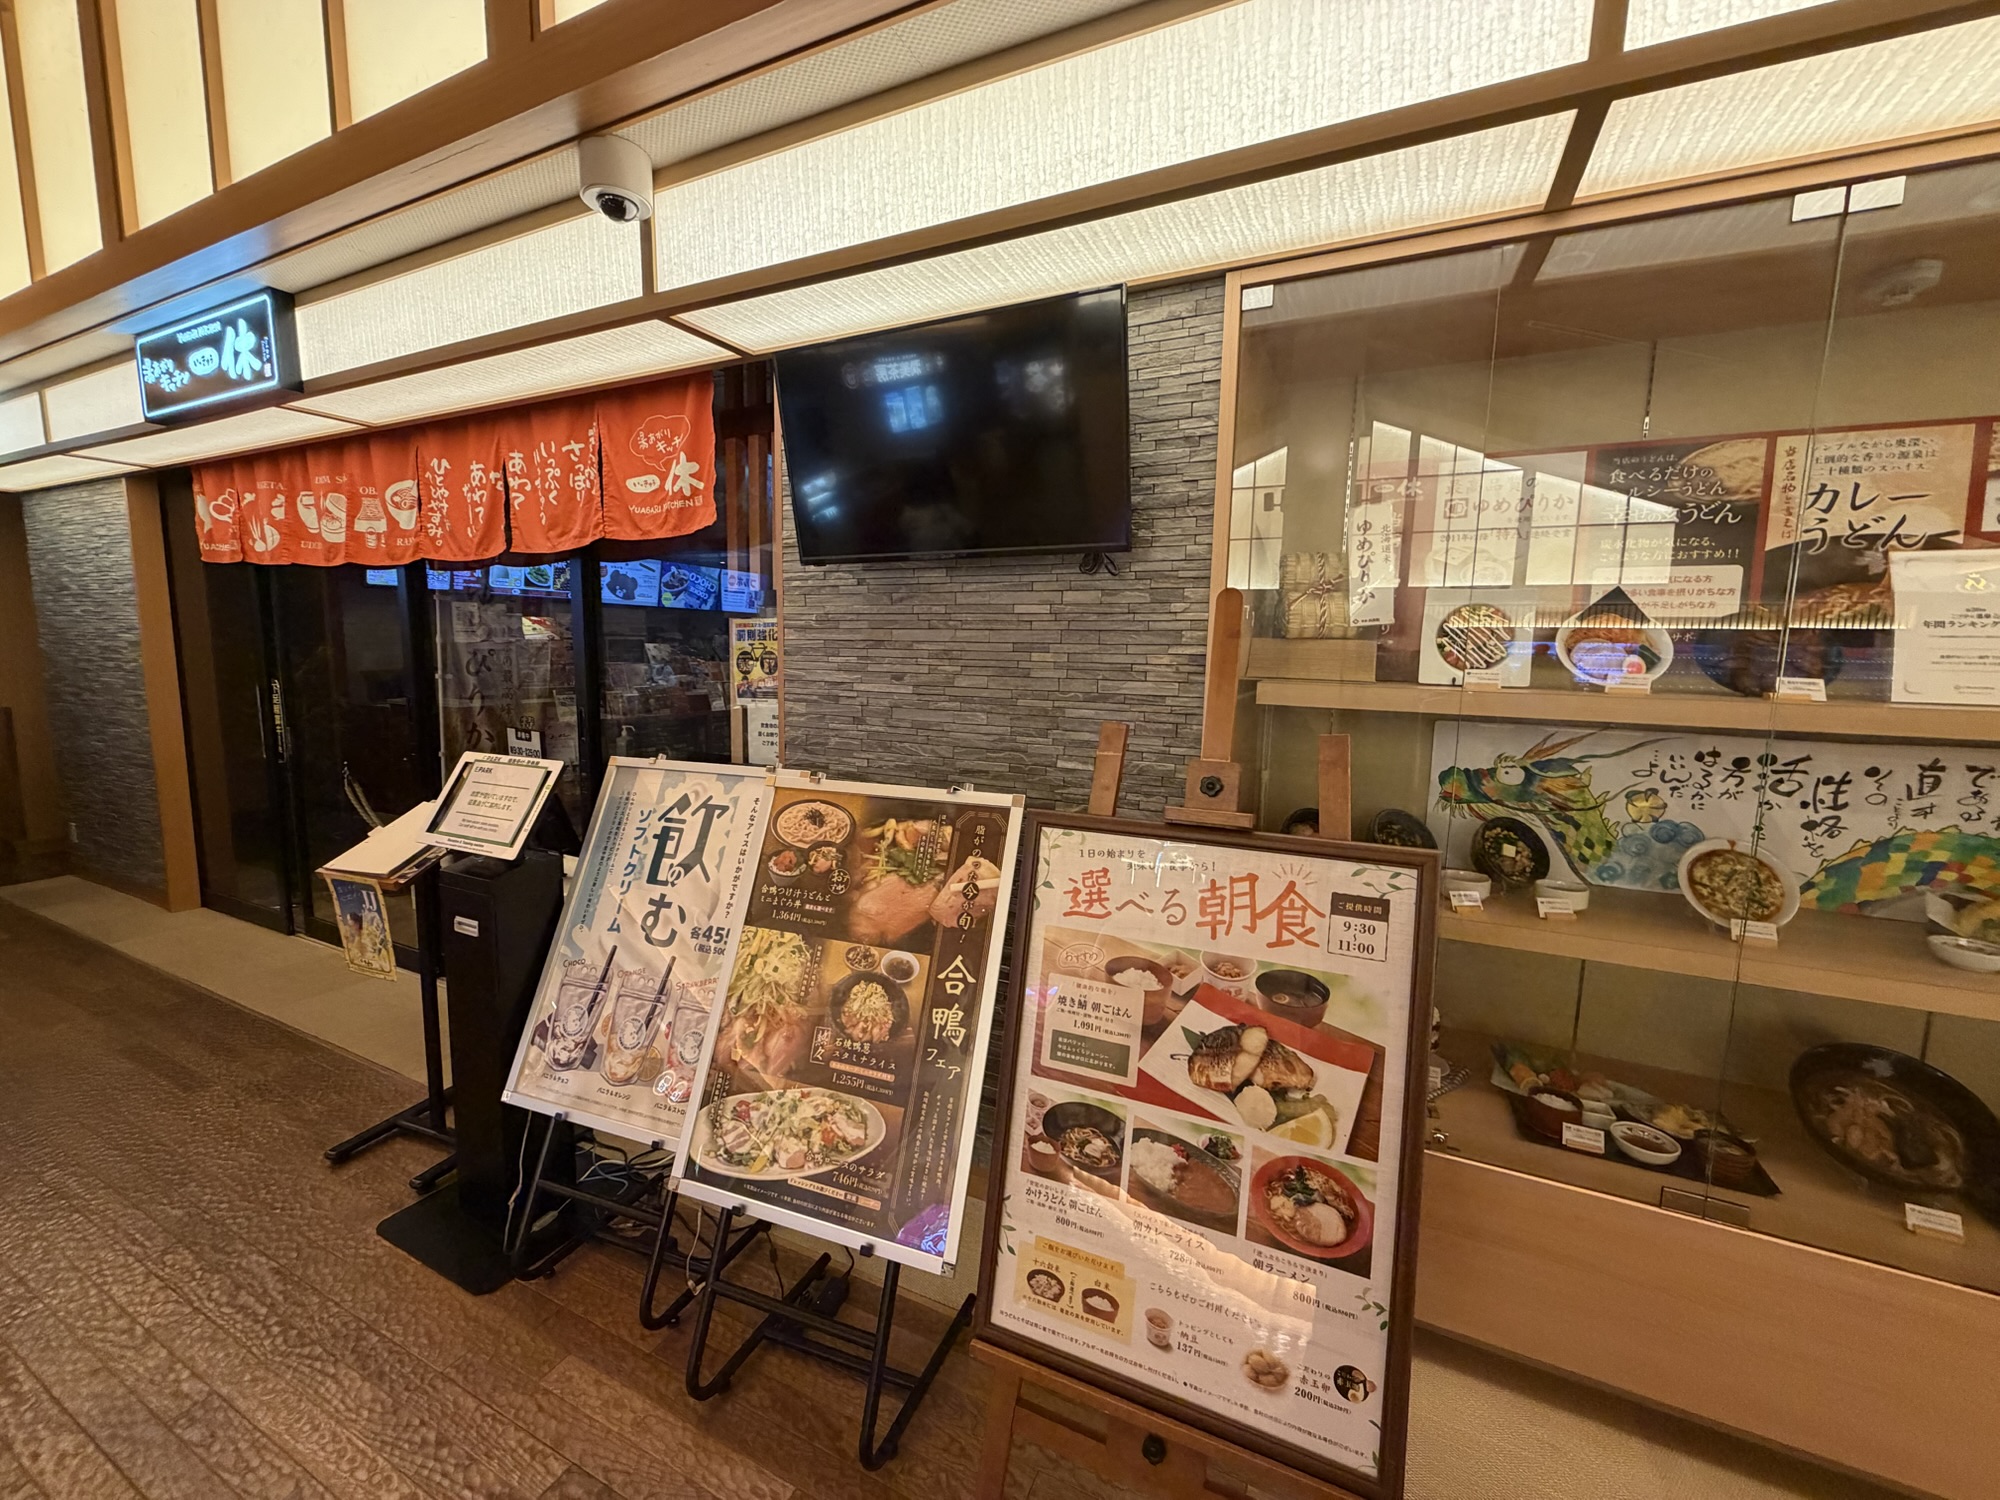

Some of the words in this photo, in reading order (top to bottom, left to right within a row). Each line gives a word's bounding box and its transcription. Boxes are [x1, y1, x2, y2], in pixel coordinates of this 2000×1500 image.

[638, 428, 671, 450] 湯あがり
[540, 441, 562, 506] いっぷく
[1609, 465, 1714, 485] 食べるだけの
[1472, 494, 1574, 514] ゆめぴりか
[1805, 481, 1933, 515] カレー
[1802, 513, 1928, 554] うどん
[1355, 519, 1377, 605] ゆめぴりか
[1690, 745, 1722, 811] はるかに
[1719, 756, 1753, 801] 方が
[1799, 771, 1853, 858] 性格を
[1079, 849, 1146, 859] 1日の始まりを
[606, 809, 653, 935] ソフトクリーム
[1062, 866, 1327, 950] 選べる朝食
[1338, 901, 1383, 915] ご提供時間
[1343, 920, 1377, 936] 9:30
[1337, 939, 1376, 956] 11:00
[1057, 994, 1087, 1011] 焼き鯖
[1091, 1001, 1132, 1018] 朝ごはん
[1073, 1019, 1102, 1033] 1,091円
[832, 1050, 896, 1070] スタミナライス
[832, 1170, 858, 1189] 746円
[1025, 1187, 1066, 1208] かけうどん
[1068, 1199, 1103, 1218] 朝ごはん
[1055, 1214, 1077, 1229] 800円
[1132, 1217, 1206, 1252] 朝カレーライス
[1169, 1249, 1193, 1266] 728円
[1253, 1258, 1311, 1284] 朝ラーメン
[1292, 1290, 1321, 1308] 800円
[1179, 1320, 1235, 1346] トッピングとしても
[1176, 1341, 1201, 1359] 137円
[1294, 1386, 1321, 1406] 200円
